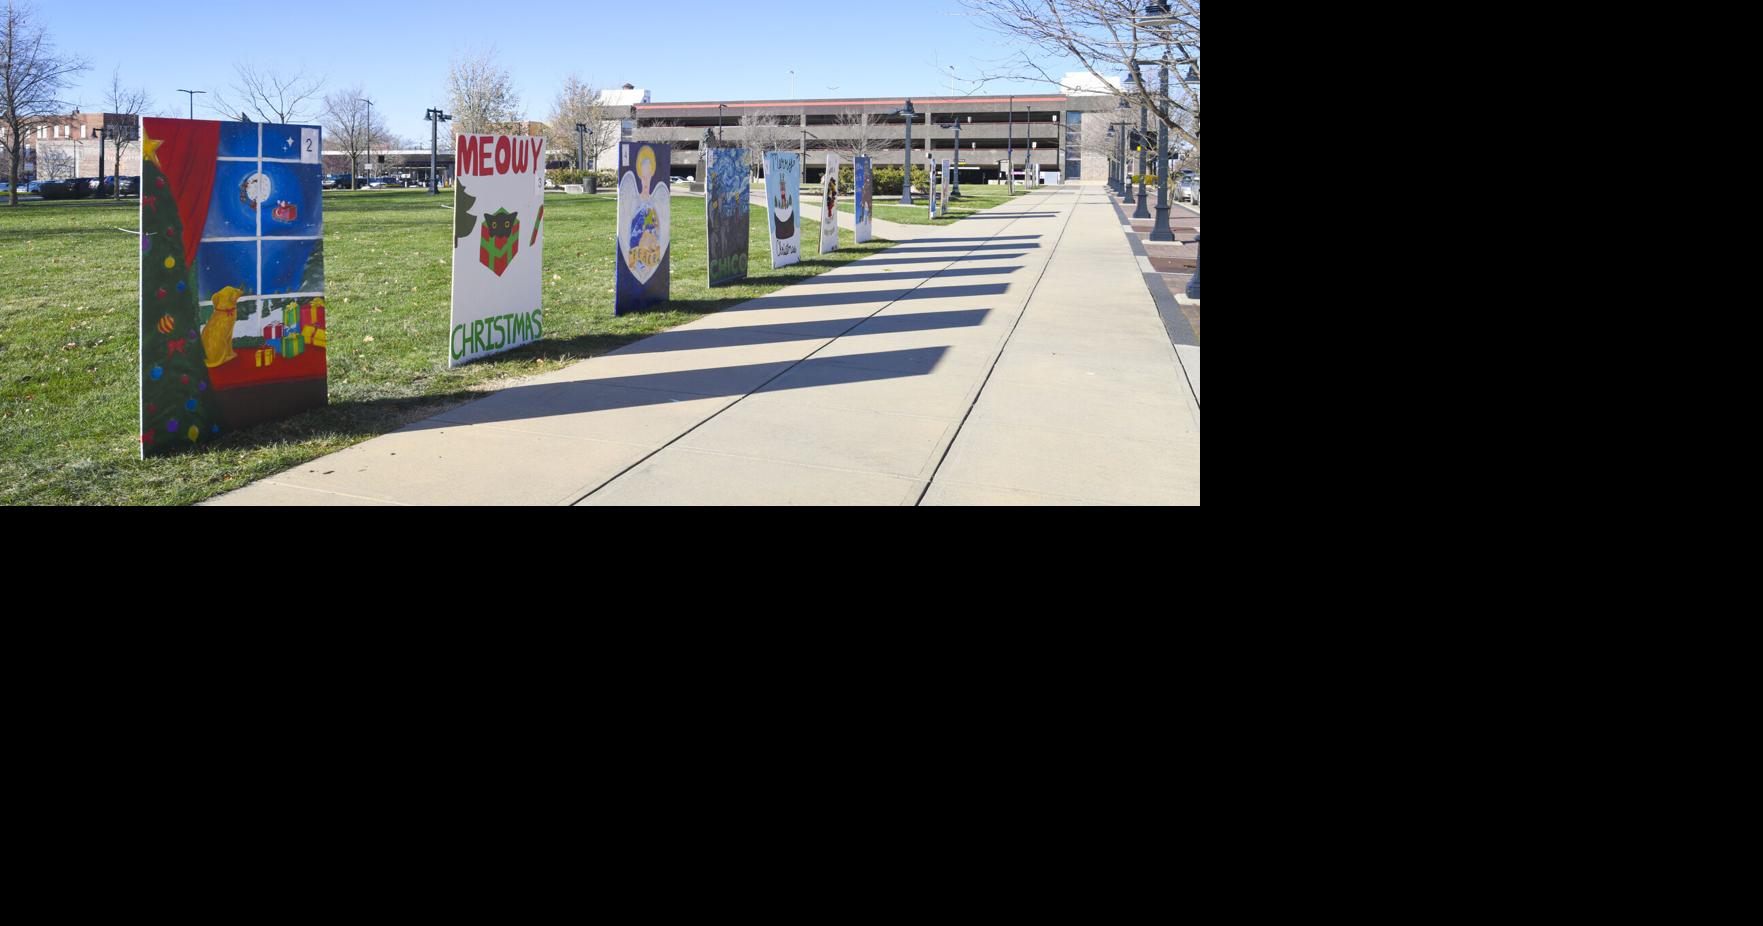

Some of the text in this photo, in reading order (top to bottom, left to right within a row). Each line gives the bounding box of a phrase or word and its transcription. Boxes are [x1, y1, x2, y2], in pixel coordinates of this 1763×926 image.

[306, 137, 313, 152] 2
[457, 134, 543, 176] MEOWY
[537, 177, 542, 188] 3
[710, 253, 747, 279] CHICO
[451, 308, 543, 360] CHRISTMAS
